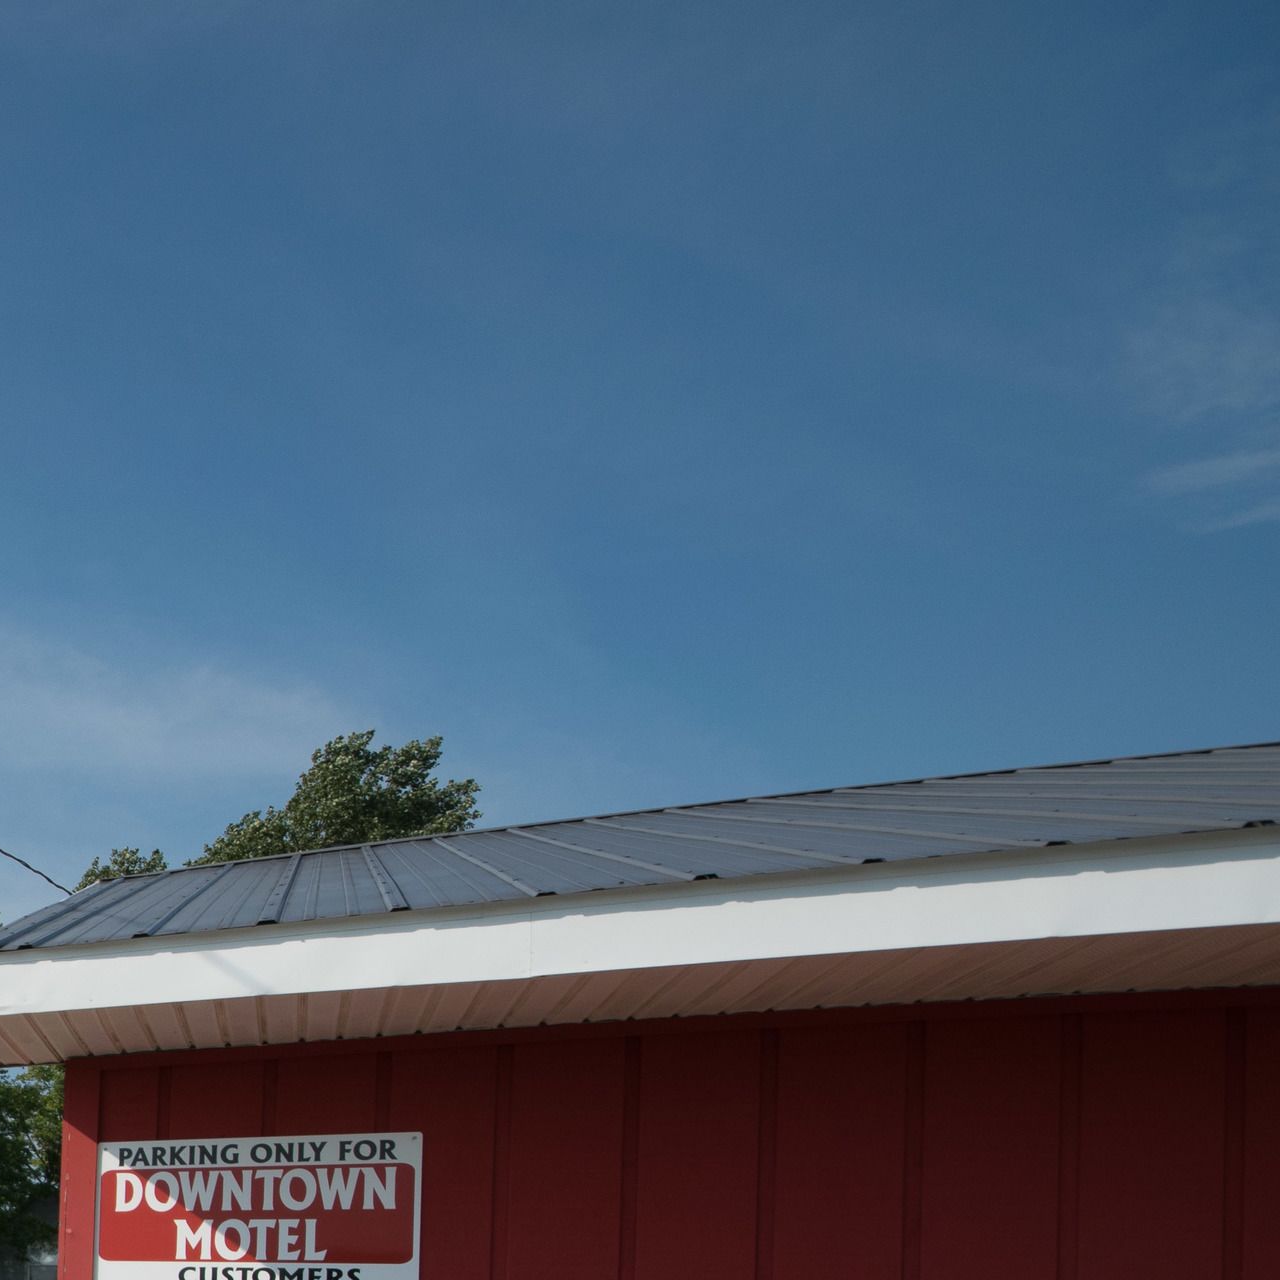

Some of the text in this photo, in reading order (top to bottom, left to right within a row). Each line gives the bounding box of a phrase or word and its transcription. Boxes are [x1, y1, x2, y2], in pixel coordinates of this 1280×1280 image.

[119, 1139, 398, 1167] PARKING ONLY FOR
[115, 1166, 397, 1212] DOWNTOWN
[174, 1218, 328, 1261] MOTEL
